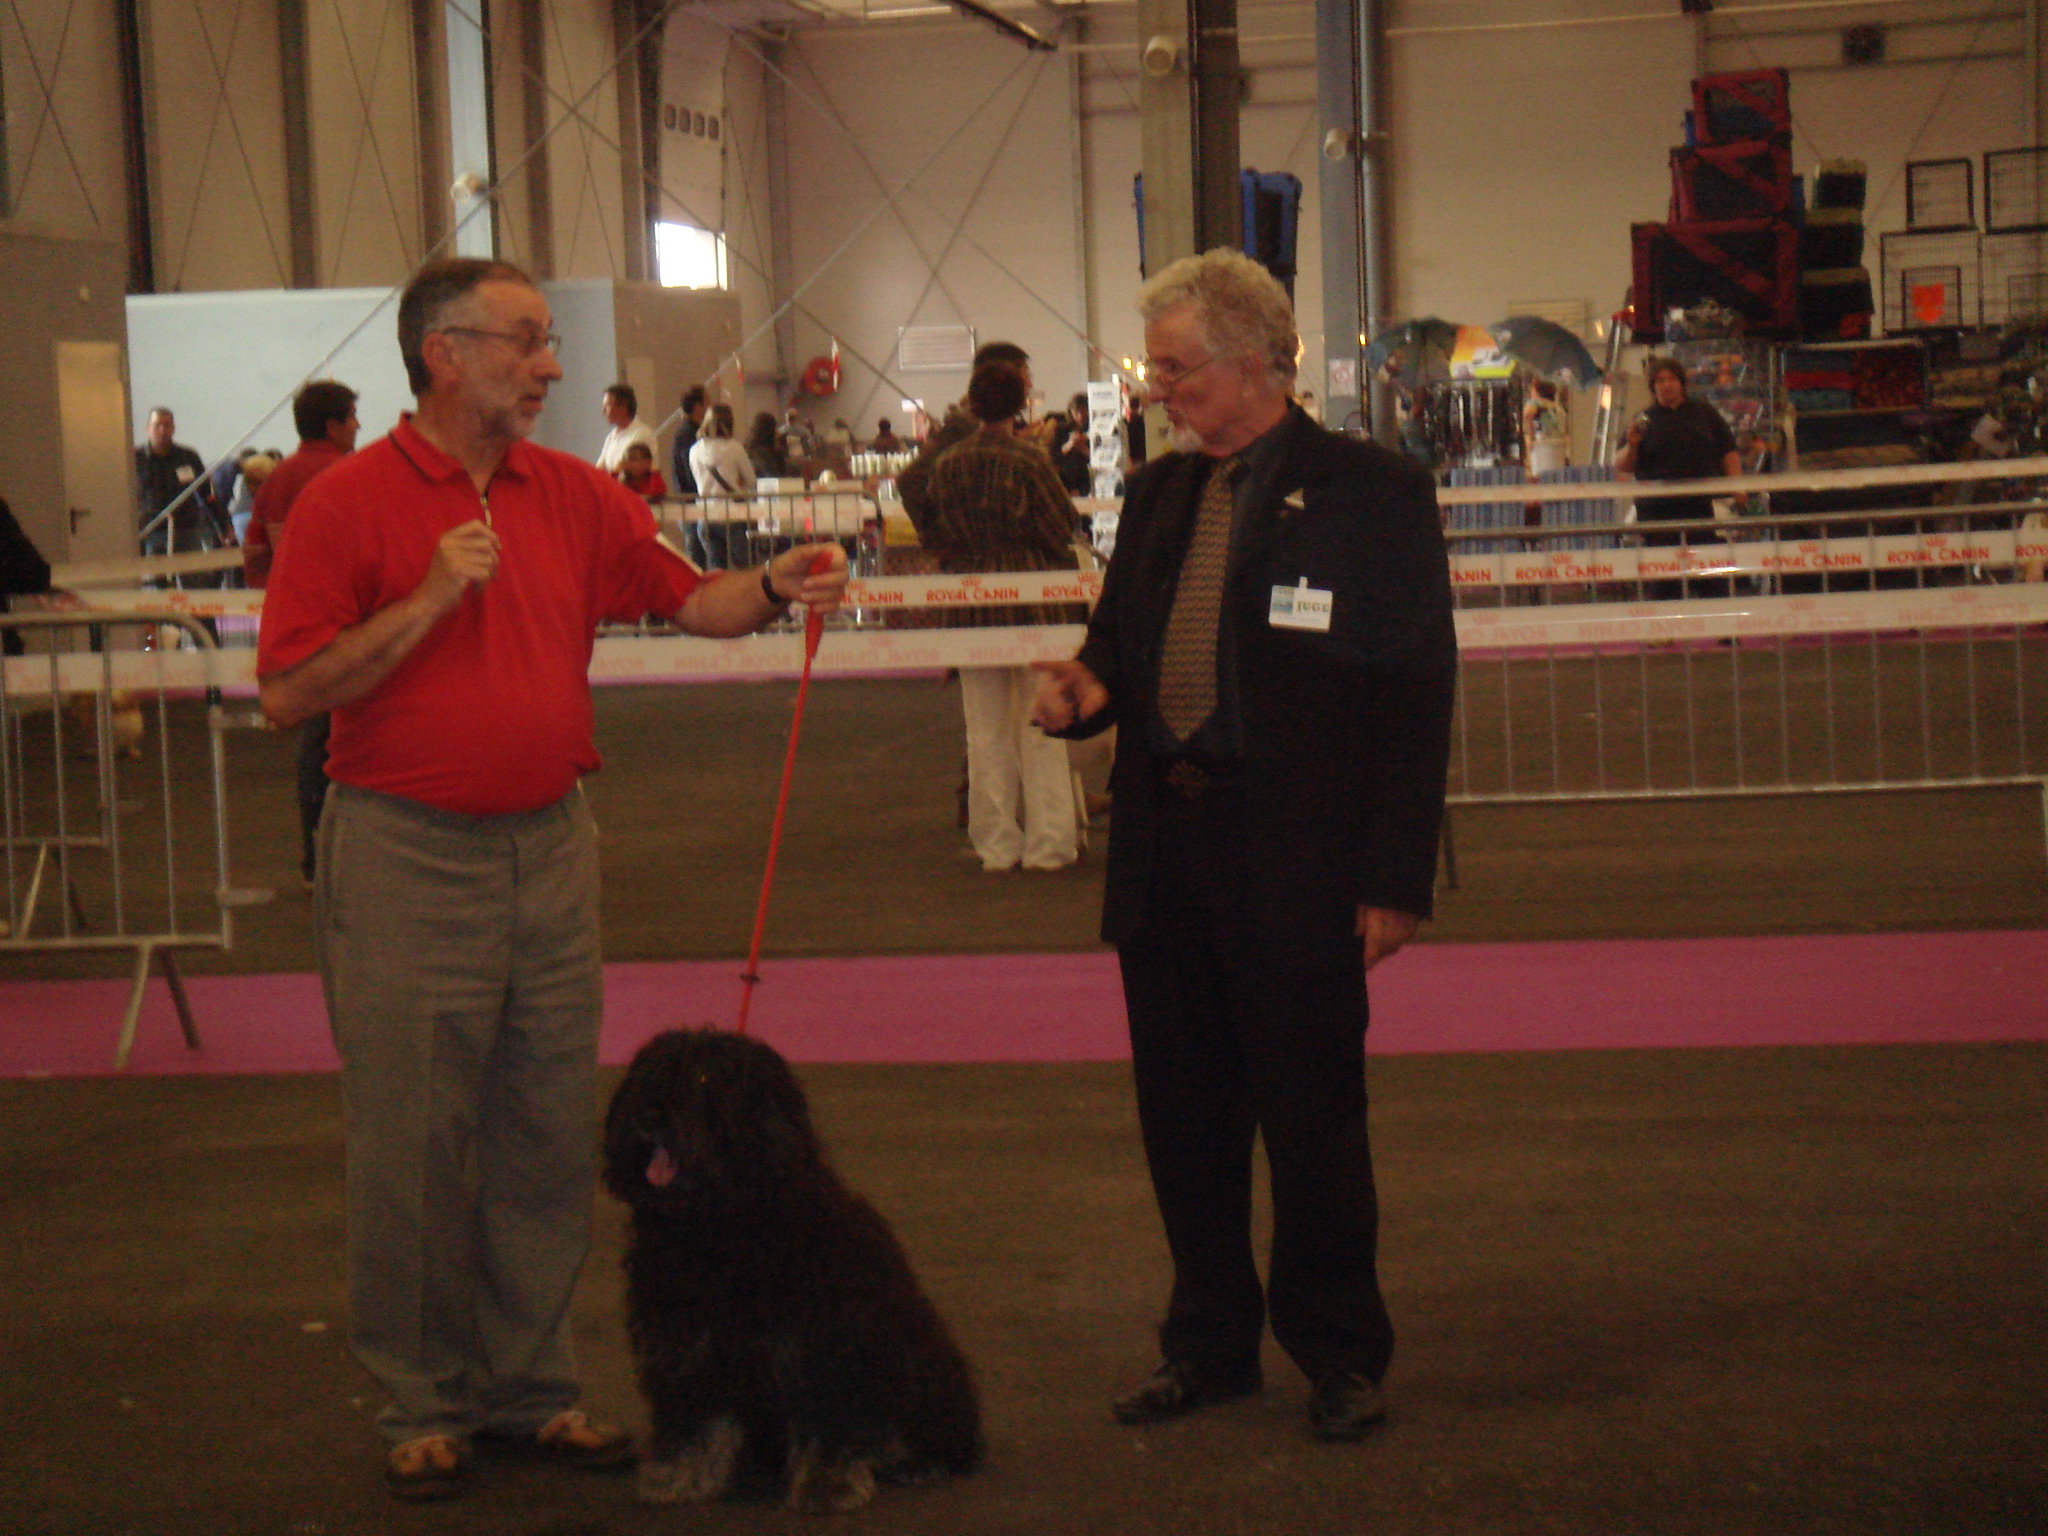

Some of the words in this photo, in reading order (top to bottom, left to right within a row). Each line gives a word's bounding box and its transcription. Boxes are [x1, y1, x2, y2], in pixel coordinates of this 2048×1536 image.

[1886, 548, 1933, 563] ROYAL
[1938, 546, 1990, 561] CANIN
[2014, 544, 2048, 558] ROY
[1761, 554, 1806, 568] ROYAL
[1812, 552, 1863, 567] CANIN
[1515, 566, 1559, 580] ROYAL
[1565, 564, 1614, 579] CANIN
[858, 590, 903, 604] CANIN
[926, 589, 968, 602] ROYAL
[974, 587, 1019, 601] CANIN
[1042, 585, 1084, 598] ROYAL
[1296, 601, 1330, 613] JUGE
